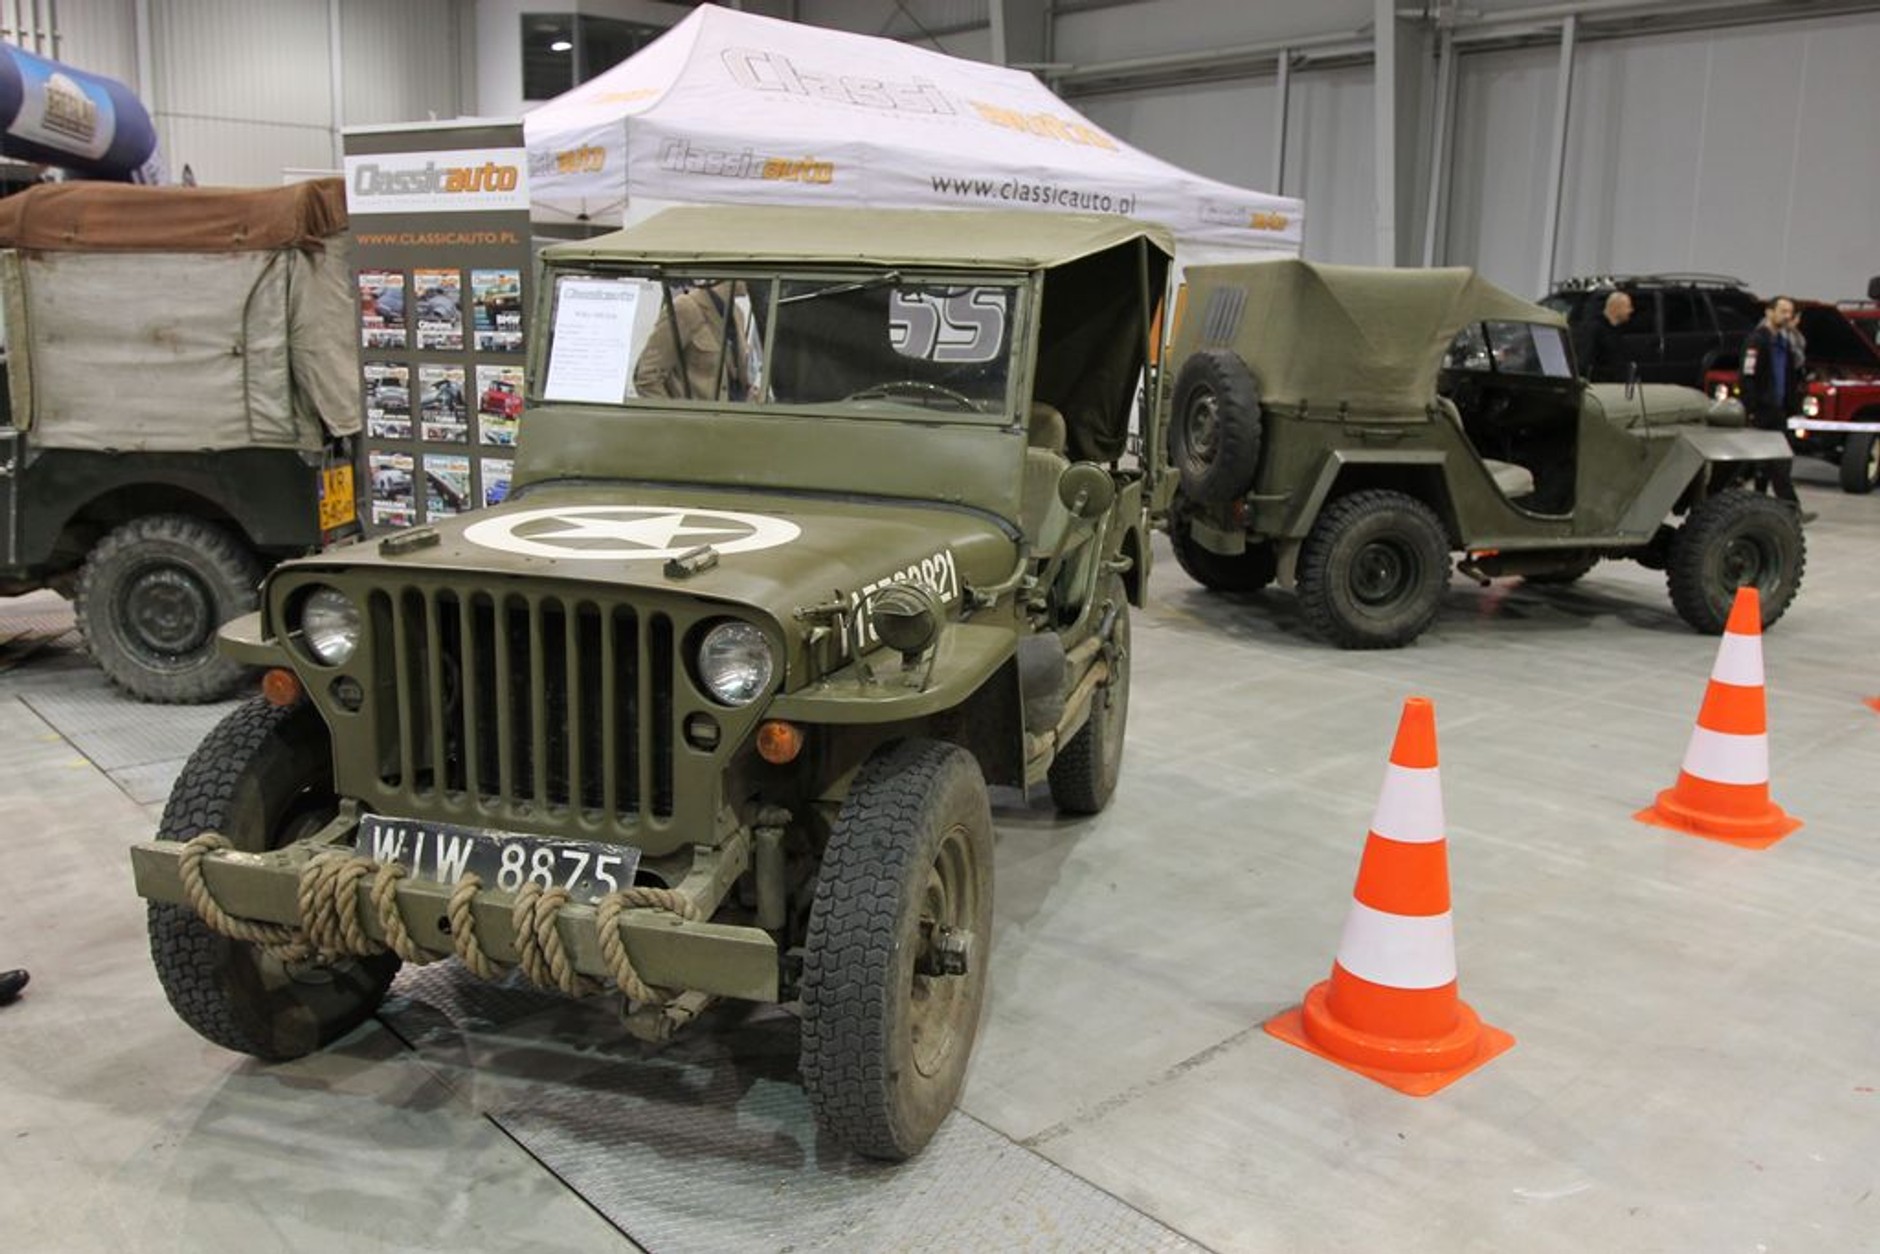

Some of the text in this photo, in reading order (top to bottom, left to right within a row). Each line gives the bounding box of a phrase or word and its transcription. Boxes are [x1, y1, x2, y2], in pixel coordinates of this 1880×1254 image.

[354, 160, 519, 196] Classicauto
[659, 134, 836, 185] Classicauto
[930, 175, 1137, 215] www.classicauto.pl
[356, 230, 519, 246] WWW.CLASSICAUTO.PL
[497, 843, 622, 903] 8875
